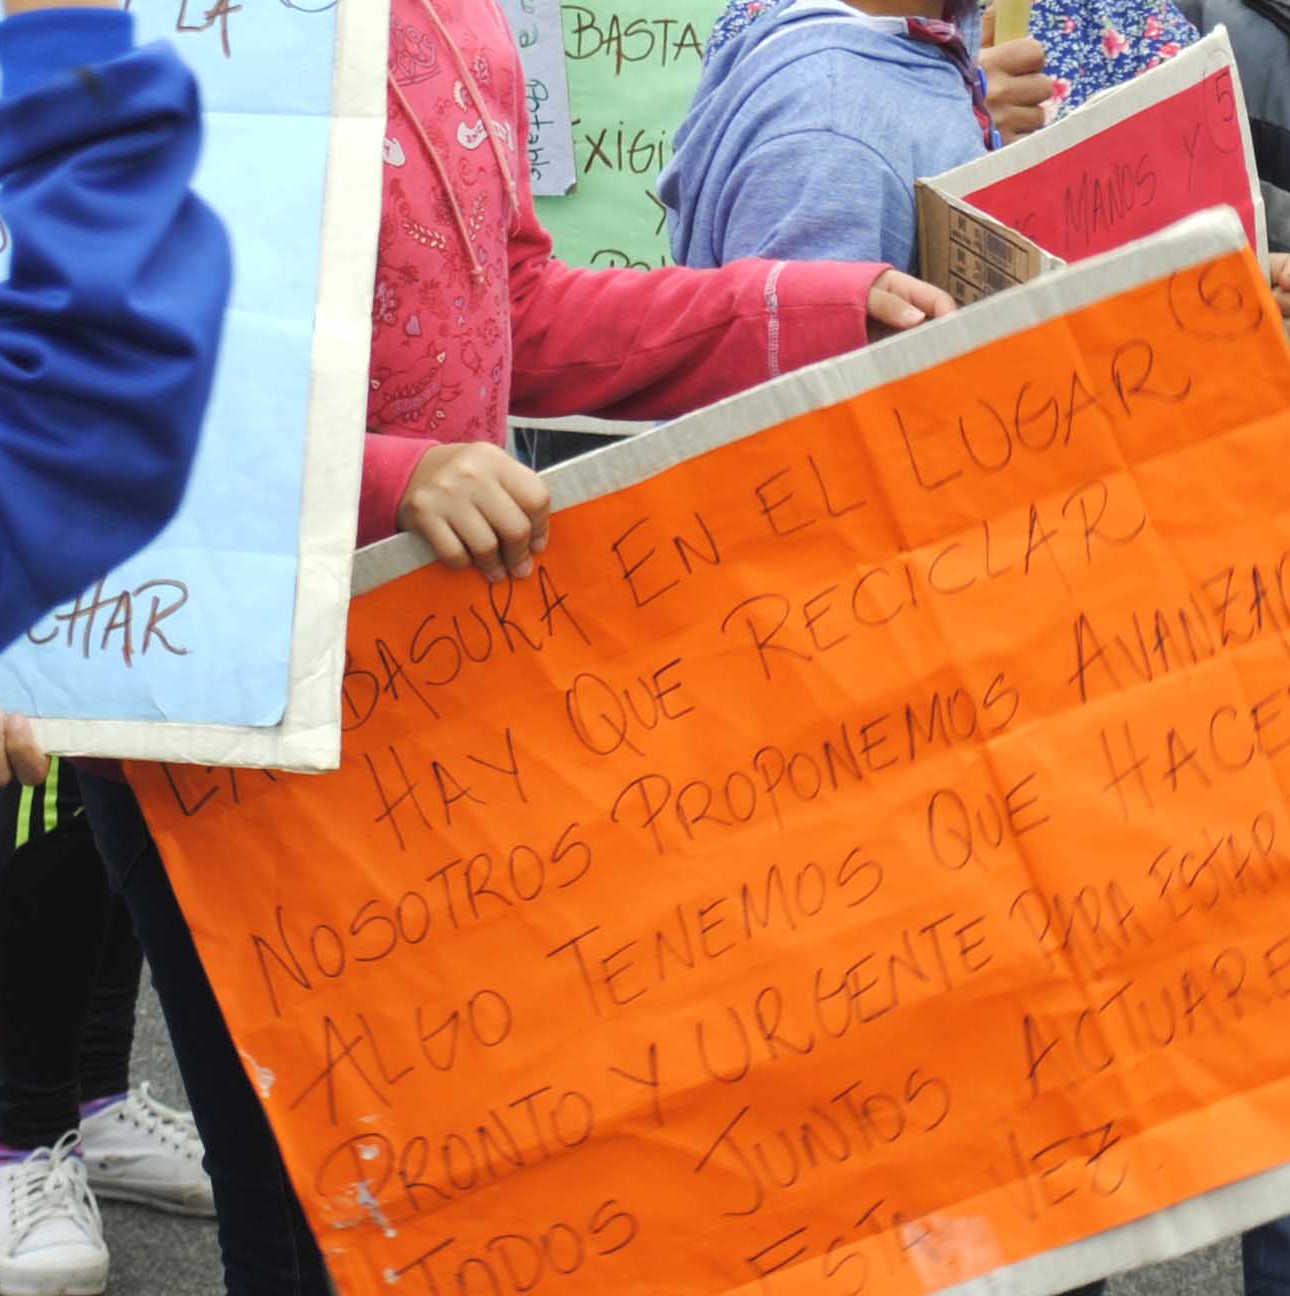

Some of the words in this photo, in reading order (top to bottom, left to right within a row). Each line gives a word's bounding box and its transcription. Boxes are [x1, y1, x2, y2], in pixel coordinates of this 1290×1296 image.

[561, 4, 704, 76] BASTA
[611, 517, 722, 609] EN
[757, 454, 867, 539] EL
[893, 339, 1192, 491] LUGAR
[364, 726, 529, 851] HAY
[565, 658, 697, 760] QUE
[722, 481, 1148, 683] RECICLAR
[250, 823, 594, 1018] NOSOTROS
[611, 672, 1021, 859] PROPONEMOS
[290, 986, 511, 1126] ALGO
[547, 846, 885, 1020] TENEMOS
[927, 770, 1056, 874] QUE
[610, 1041, 665, 1127] Y
[698, 916, 993, 1085] URGENTE
[695, 1069, 951, 1216] JUNTOS
